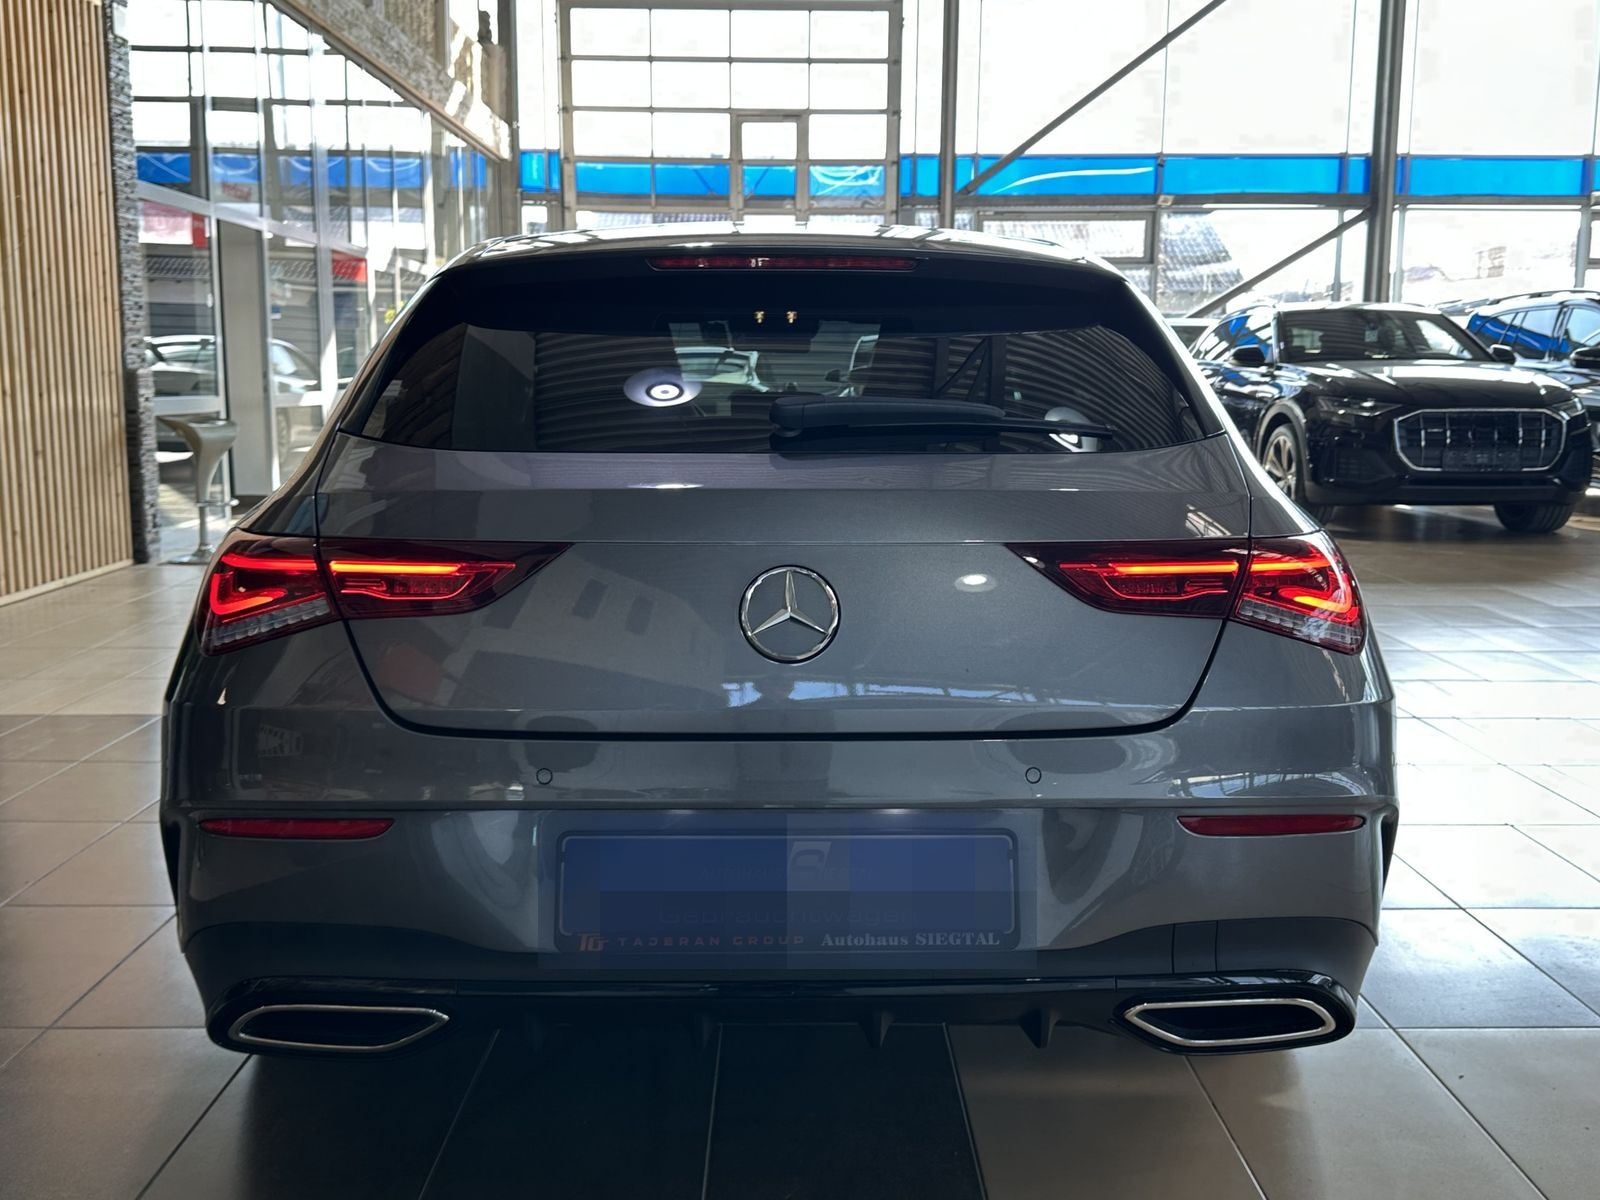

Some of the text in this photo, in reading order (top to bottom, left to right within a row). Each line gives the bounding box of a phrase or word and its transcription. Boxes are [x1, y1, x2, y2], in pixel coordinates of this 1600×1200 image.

[659, 907, 917, 926] Gebrauchtwagen
[618, 936, 720, 947] TAJERAN
[732, 935, 804, 946] GROUP
[821, 932, 1000, 946] Autohaus SIEGTAL
